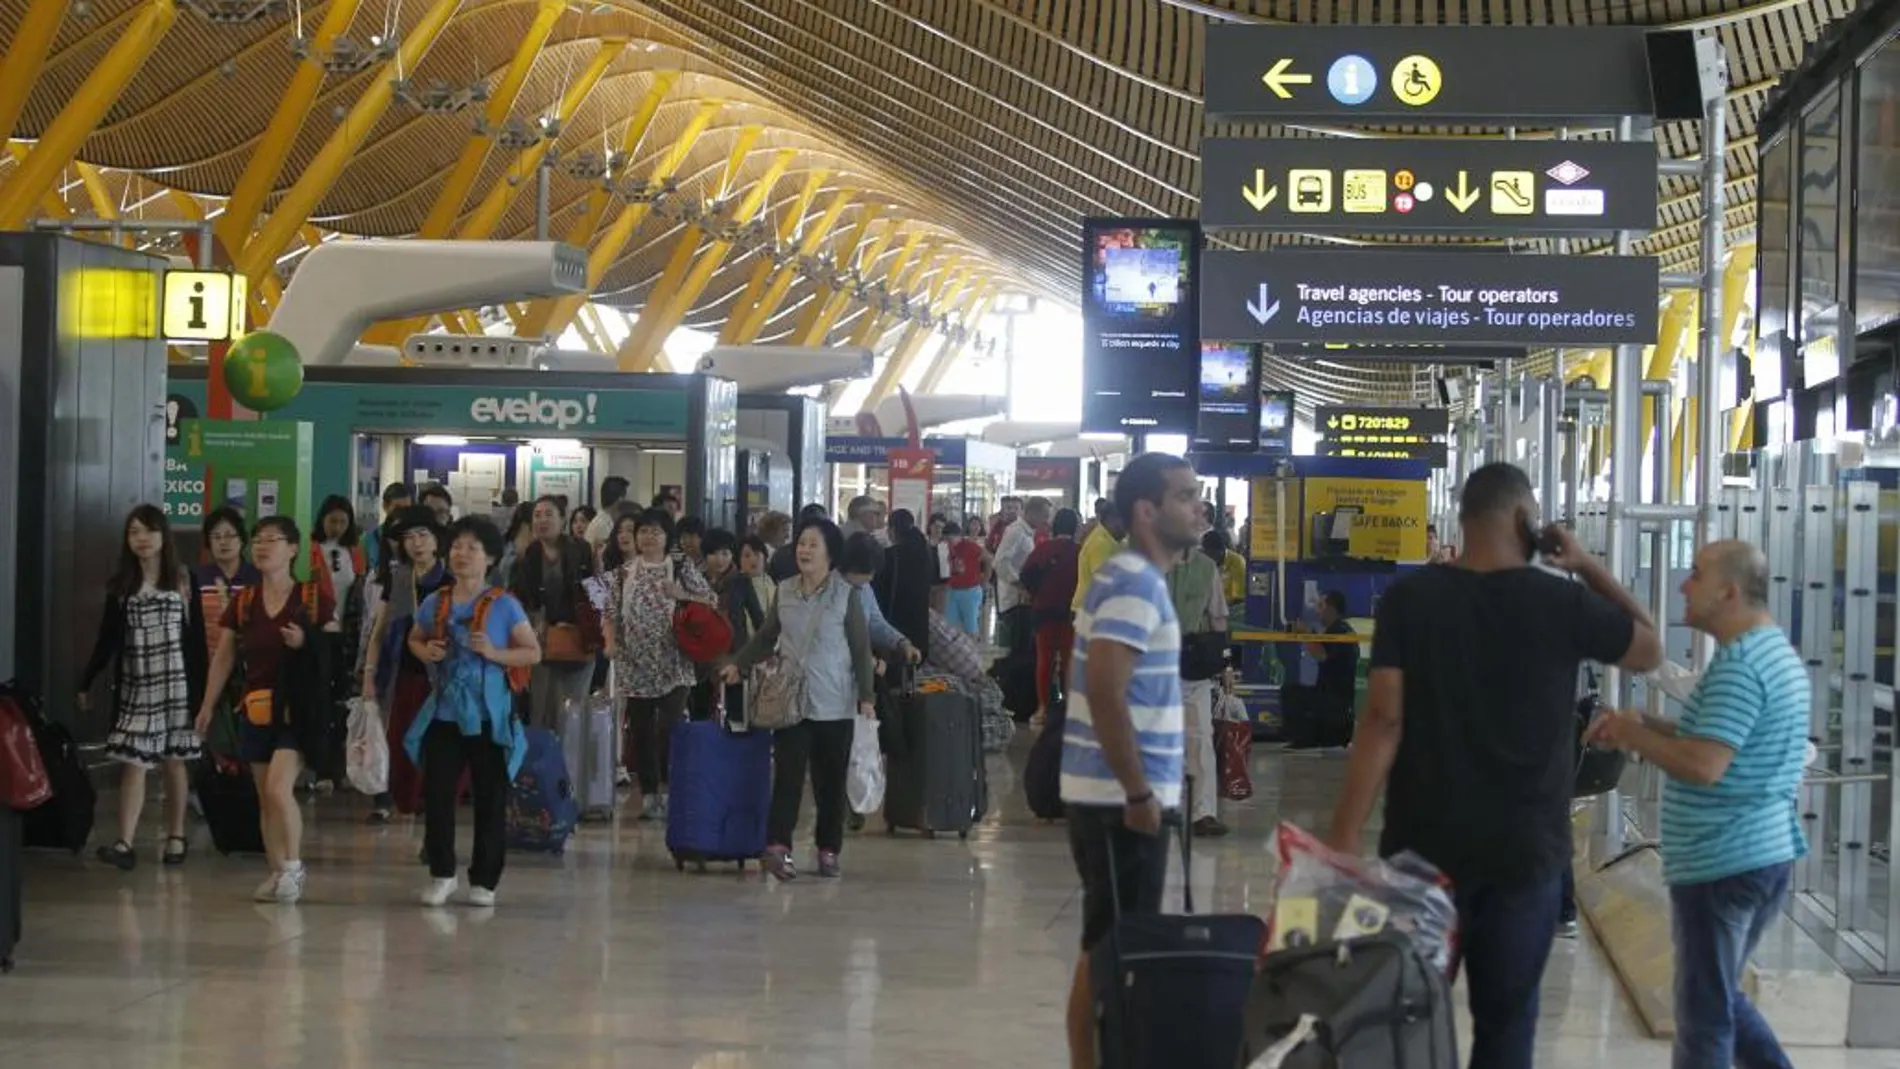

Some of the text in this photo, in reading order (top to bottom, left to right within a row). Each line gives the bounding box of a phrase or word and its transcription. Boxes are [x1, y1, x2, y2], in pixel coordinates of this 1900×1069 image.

[187, 281, 207, 329] i
[1296, 284, 1345, 301] Travel
[1348, 285, 1422, 305] agencies
[1438, 285, 1473, 302] Tour
[1478, 286, 1559, 306] operators
[1297, 306, 1383, 328] Agencias
[1387, 307, 1411, 325] de
[1415, 307, 1470, 329] viajes
[1484, 307, 1525, 326] Tour
[1528, 309, 1636, 331] operadores
[471, 390, 599, 431] evelop!
